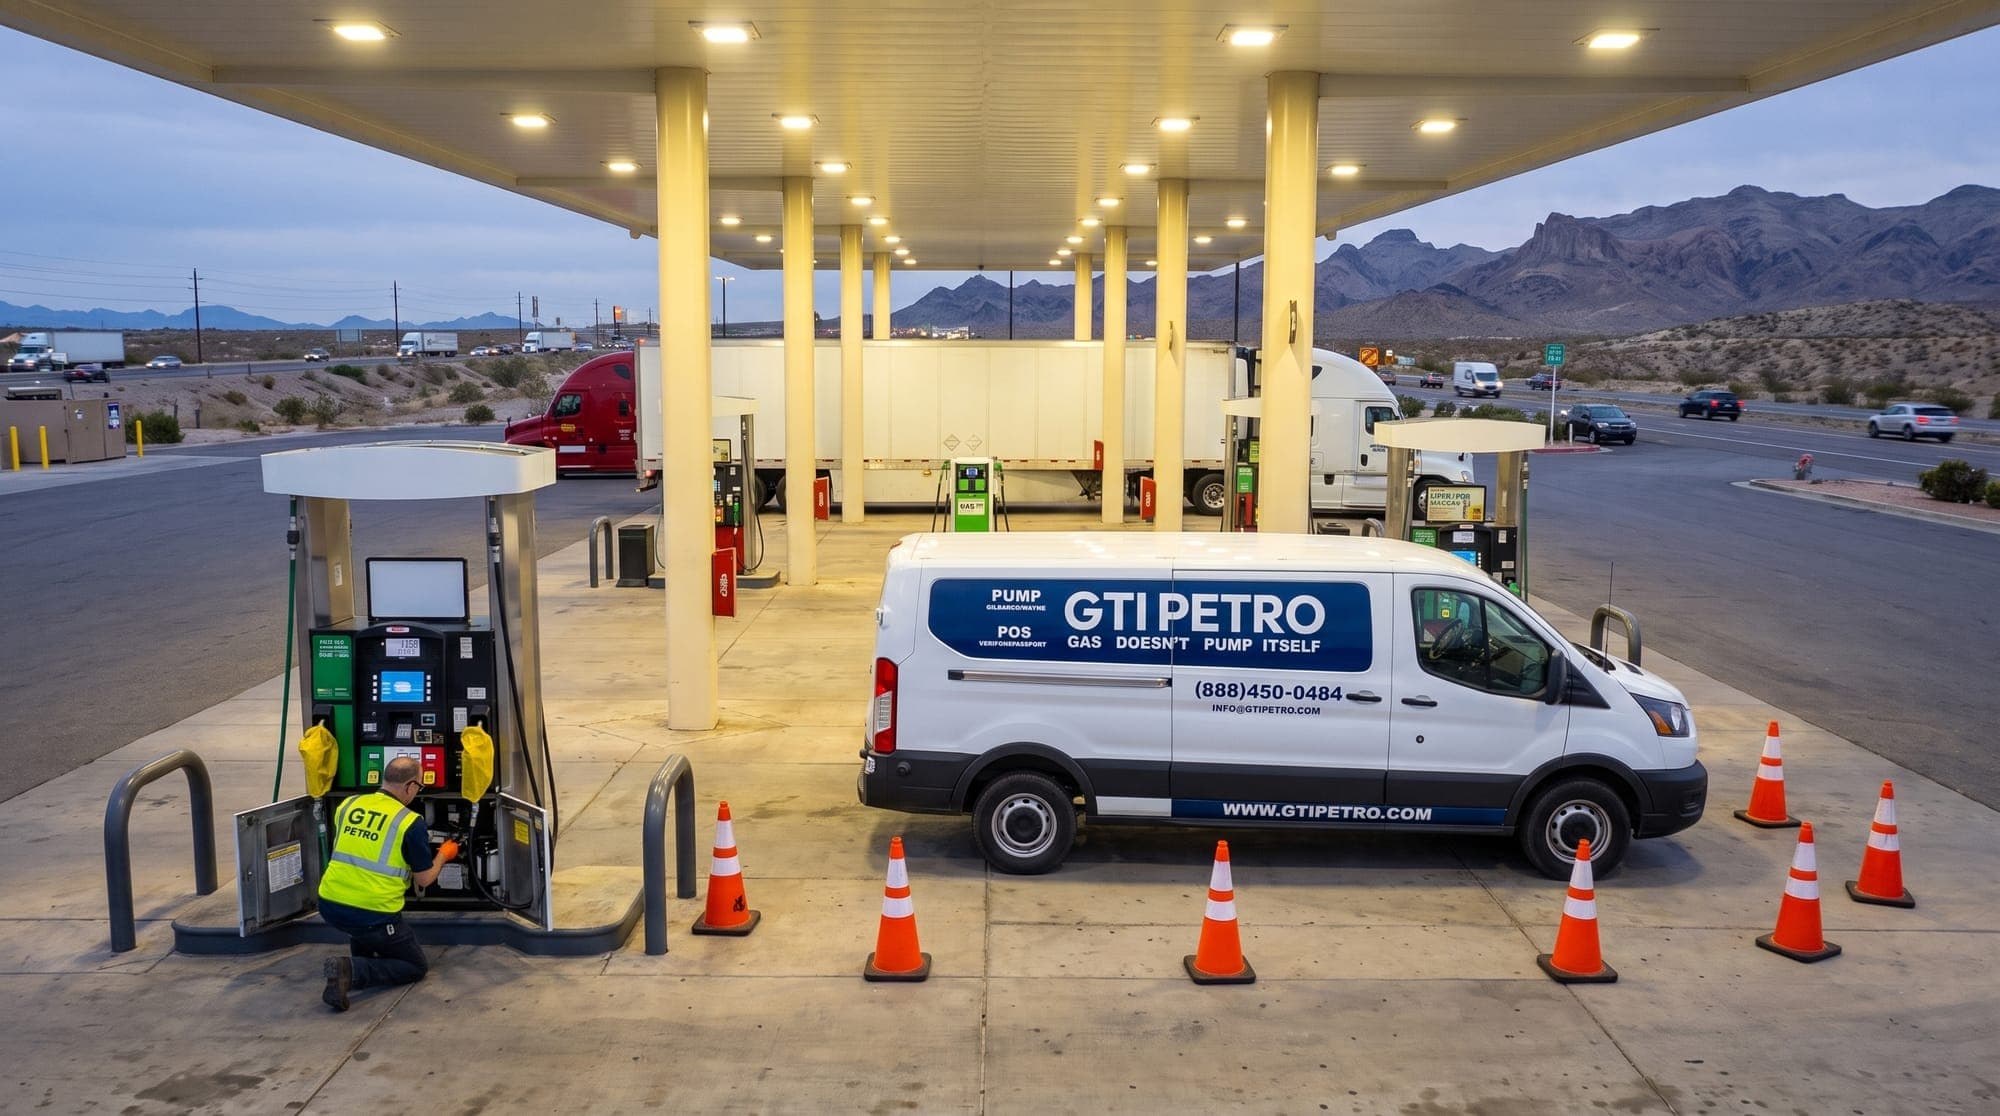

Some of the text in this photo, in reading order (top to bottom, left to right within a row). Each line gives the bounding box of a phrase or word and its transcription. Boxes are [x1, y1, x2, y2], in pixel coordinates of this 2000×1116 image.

[992, 589, 1041, 602] PUMP
[986, 604, 1046, 612] GILBARCO/WAYNE
[1064, 591, 1326, 635] GTI PETRO
[998, 626, 1032, 639] POS
[979, 640, 1047, 648] VERIFONEPASSPORT
[1067, 635, 1321, 653] GAS DOESN'T PUMP ITSELF
[1195, 681, 1343, 701] (888)450-0484
[1212, 704, 1321, 715] INFO@GTIPETRO.COM
[348, 807, 388, 831] GTI
[1222, 803, 1433, 821] WWW.GTIPETRO.COM
[343, 826, 379, 841] PETRO
